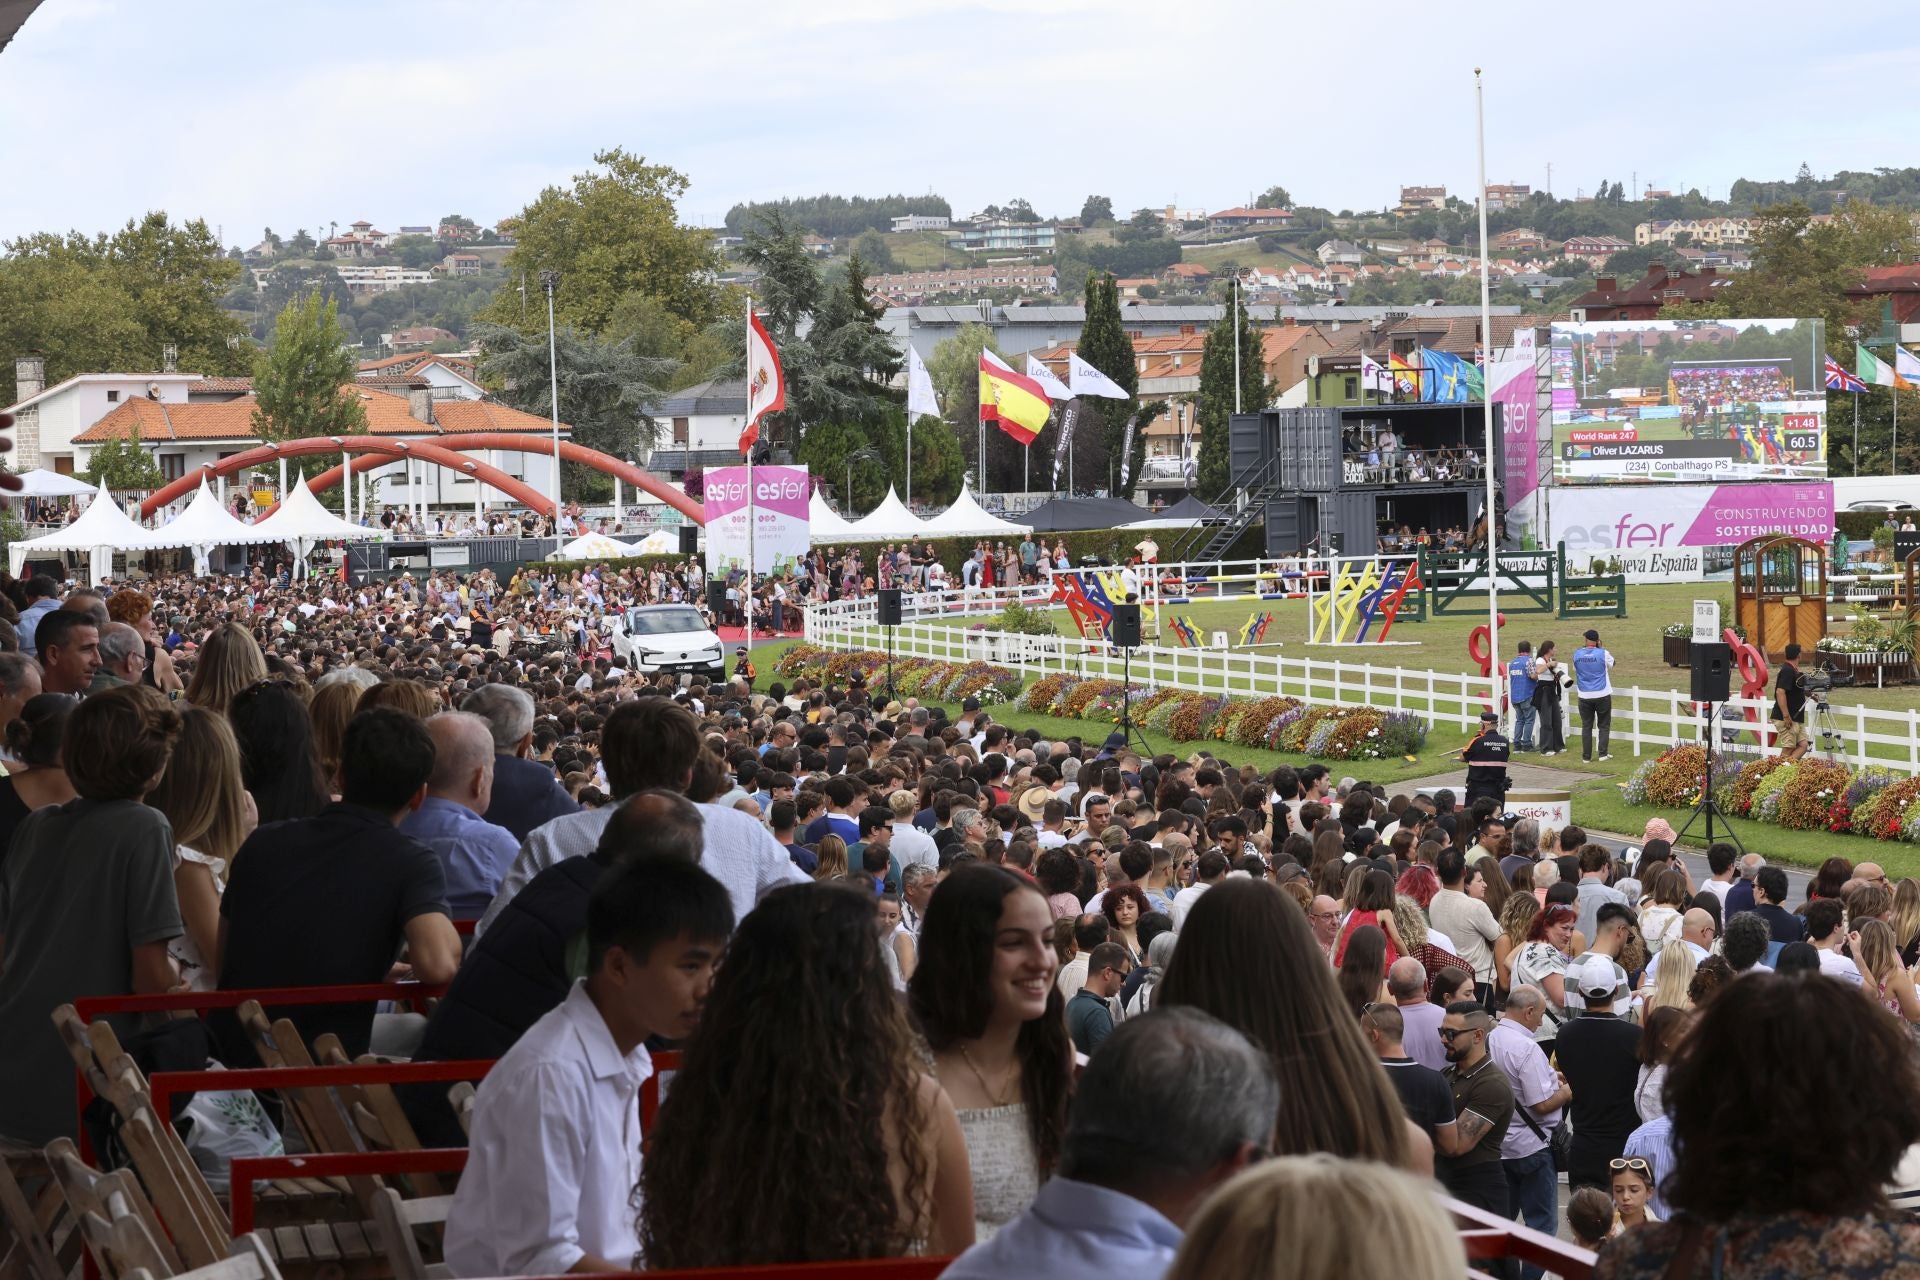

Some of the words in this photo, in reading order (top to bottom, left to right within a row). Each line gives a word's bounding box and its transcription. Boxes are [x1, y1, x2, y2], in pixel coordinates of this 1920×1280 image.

[1503, 392, 1531, 434] sfer
[1787, 418, 1815, 428] +1.48
[1057, 408, 1073, 452] SIROKO
[1573, 432, 1596, 441] World
[1598, 432, 1618, 440] Rank
[1619, 431, 1635, 440] 247
[1791, 437, 1816, 448] 60.5
[1592, 446, 1617, 456] Oliver
[1619, 445, 1664, 455] LAZARUS
[1344, 462, 1364, 473] RAW
[1625, 461, 1650, 472] (234)
[1655, 460, 1712, 472] Conbalthago
[1715, 460, 1728, 469] PS
[1344, 473, 1364, 484] COCO
[706, 478, 747, 502] esfer
[756, 477, 805, 500] esfer
[1714, 506, 1827, 520] CONSTRUYENDO
[1563, 513, 1675, 549] esfer
[1715, 524, 1828, 537] SOSTENIBILIDAD
[1650, 553, 1698, 576] España
[1518, 807, 1550, 821] gijón
